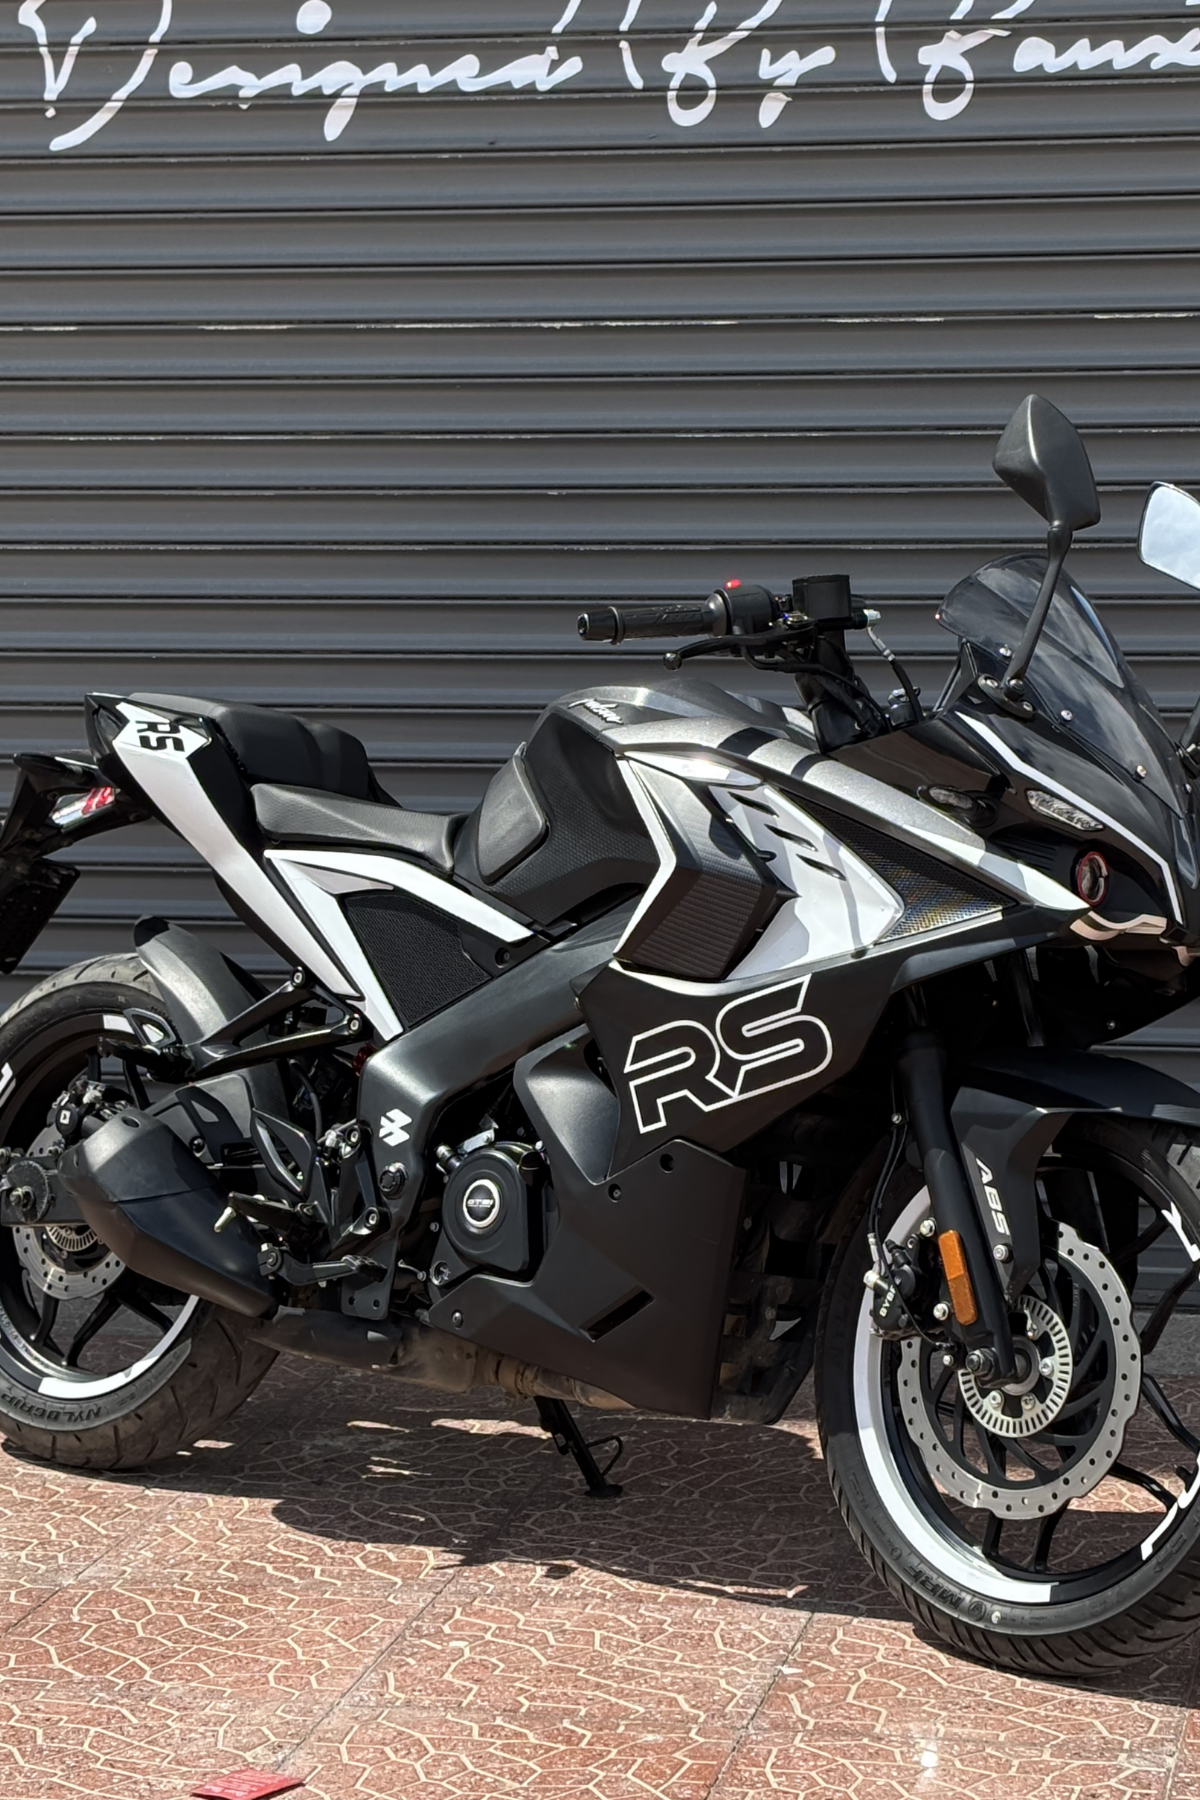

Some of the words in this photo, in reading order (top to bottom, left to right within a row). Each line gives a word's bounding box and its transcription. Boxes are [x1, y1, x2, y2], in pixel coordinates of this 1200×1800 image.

[135, 720, 185, 752] RS
[623, 972, 834, 1135] RS
[976, 1157, 1011, 1236] ABS
[1, 1393, 102, 1422] NYLOGRIP
[903, 1565, 965, 1610] MRF
